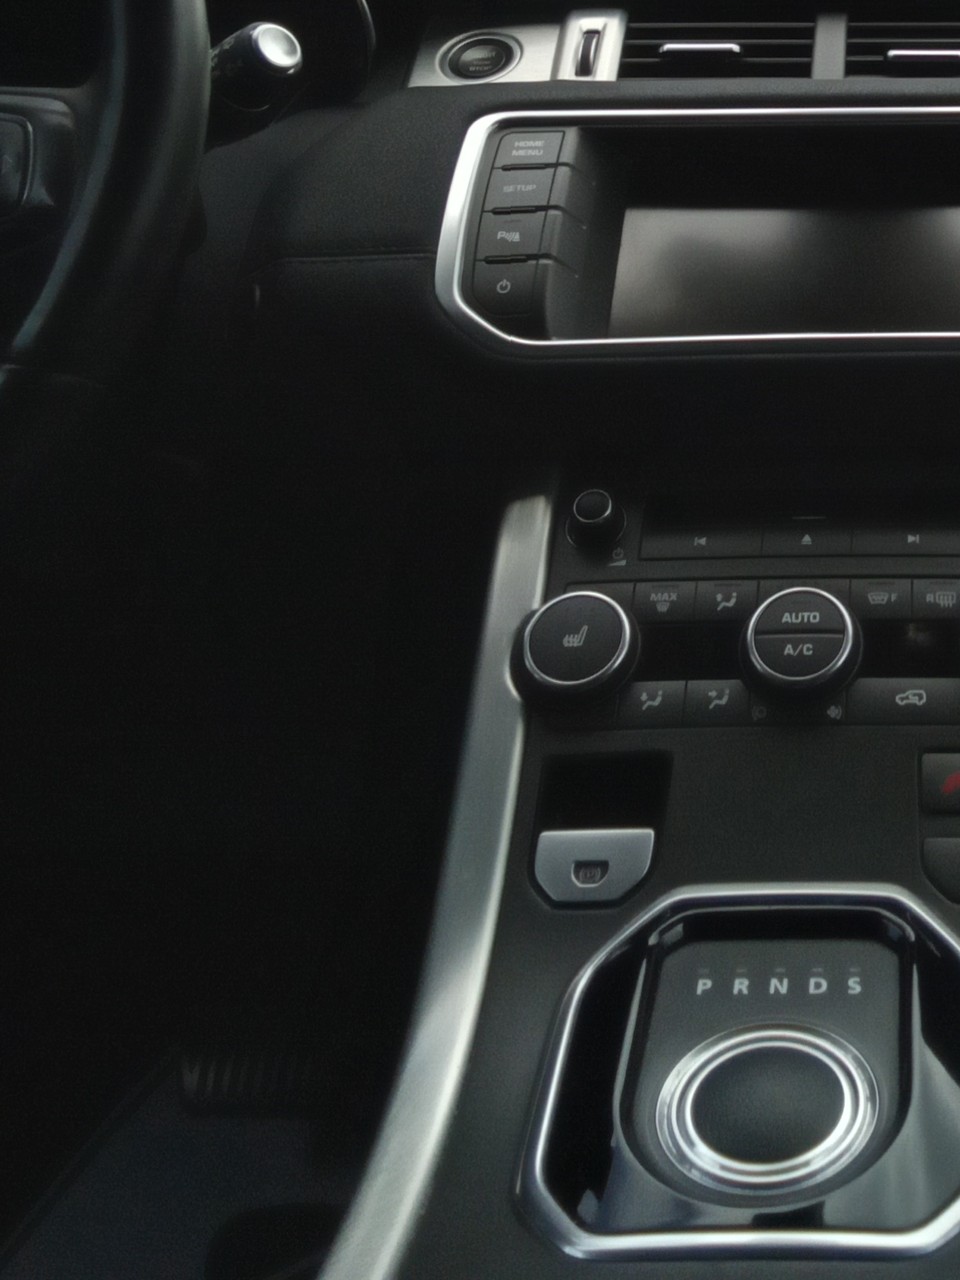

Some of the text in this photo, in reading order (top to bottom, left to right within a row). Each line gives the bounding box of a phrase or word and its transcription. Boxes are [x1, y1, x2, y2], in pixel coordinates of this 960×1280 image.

[503, 184, 537, 193] SETUP
[650, 592, 678, 602] MAX
[781, 611, 820, 624] AUTO
[783, 643, 814, 656] A/C
[696, 976, 862, 996] P R N D S
